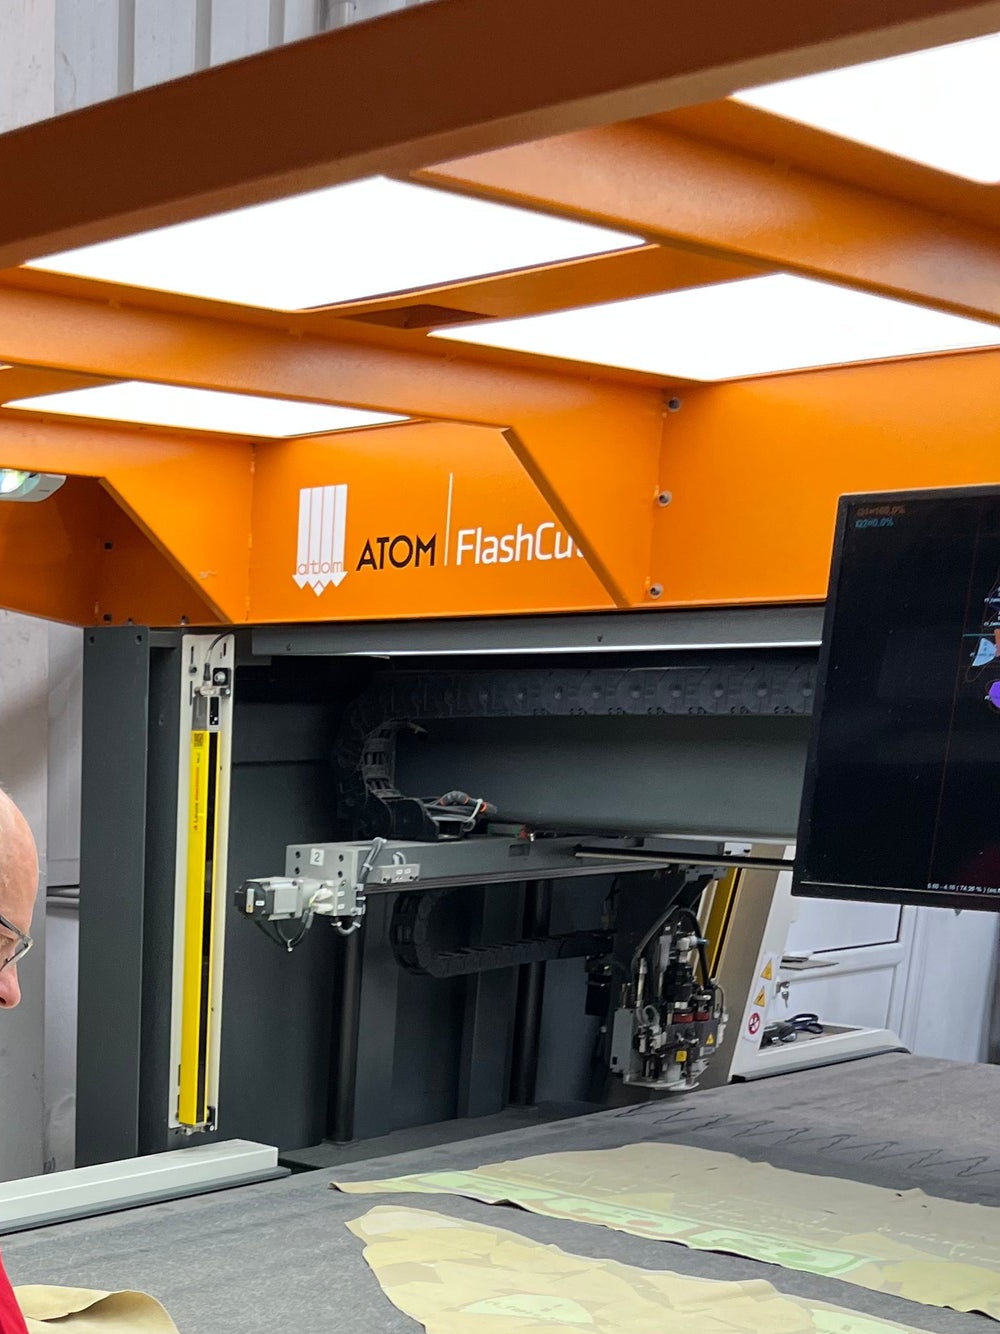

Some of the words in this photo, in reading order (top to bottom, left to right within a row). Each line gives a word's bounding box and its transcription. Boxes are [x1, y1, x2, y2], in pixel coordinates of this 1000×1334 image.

[355, 533, 437, 572] ATOM
[297, 560, 343, 576] atom
[313, 852, 321, 863] 2
